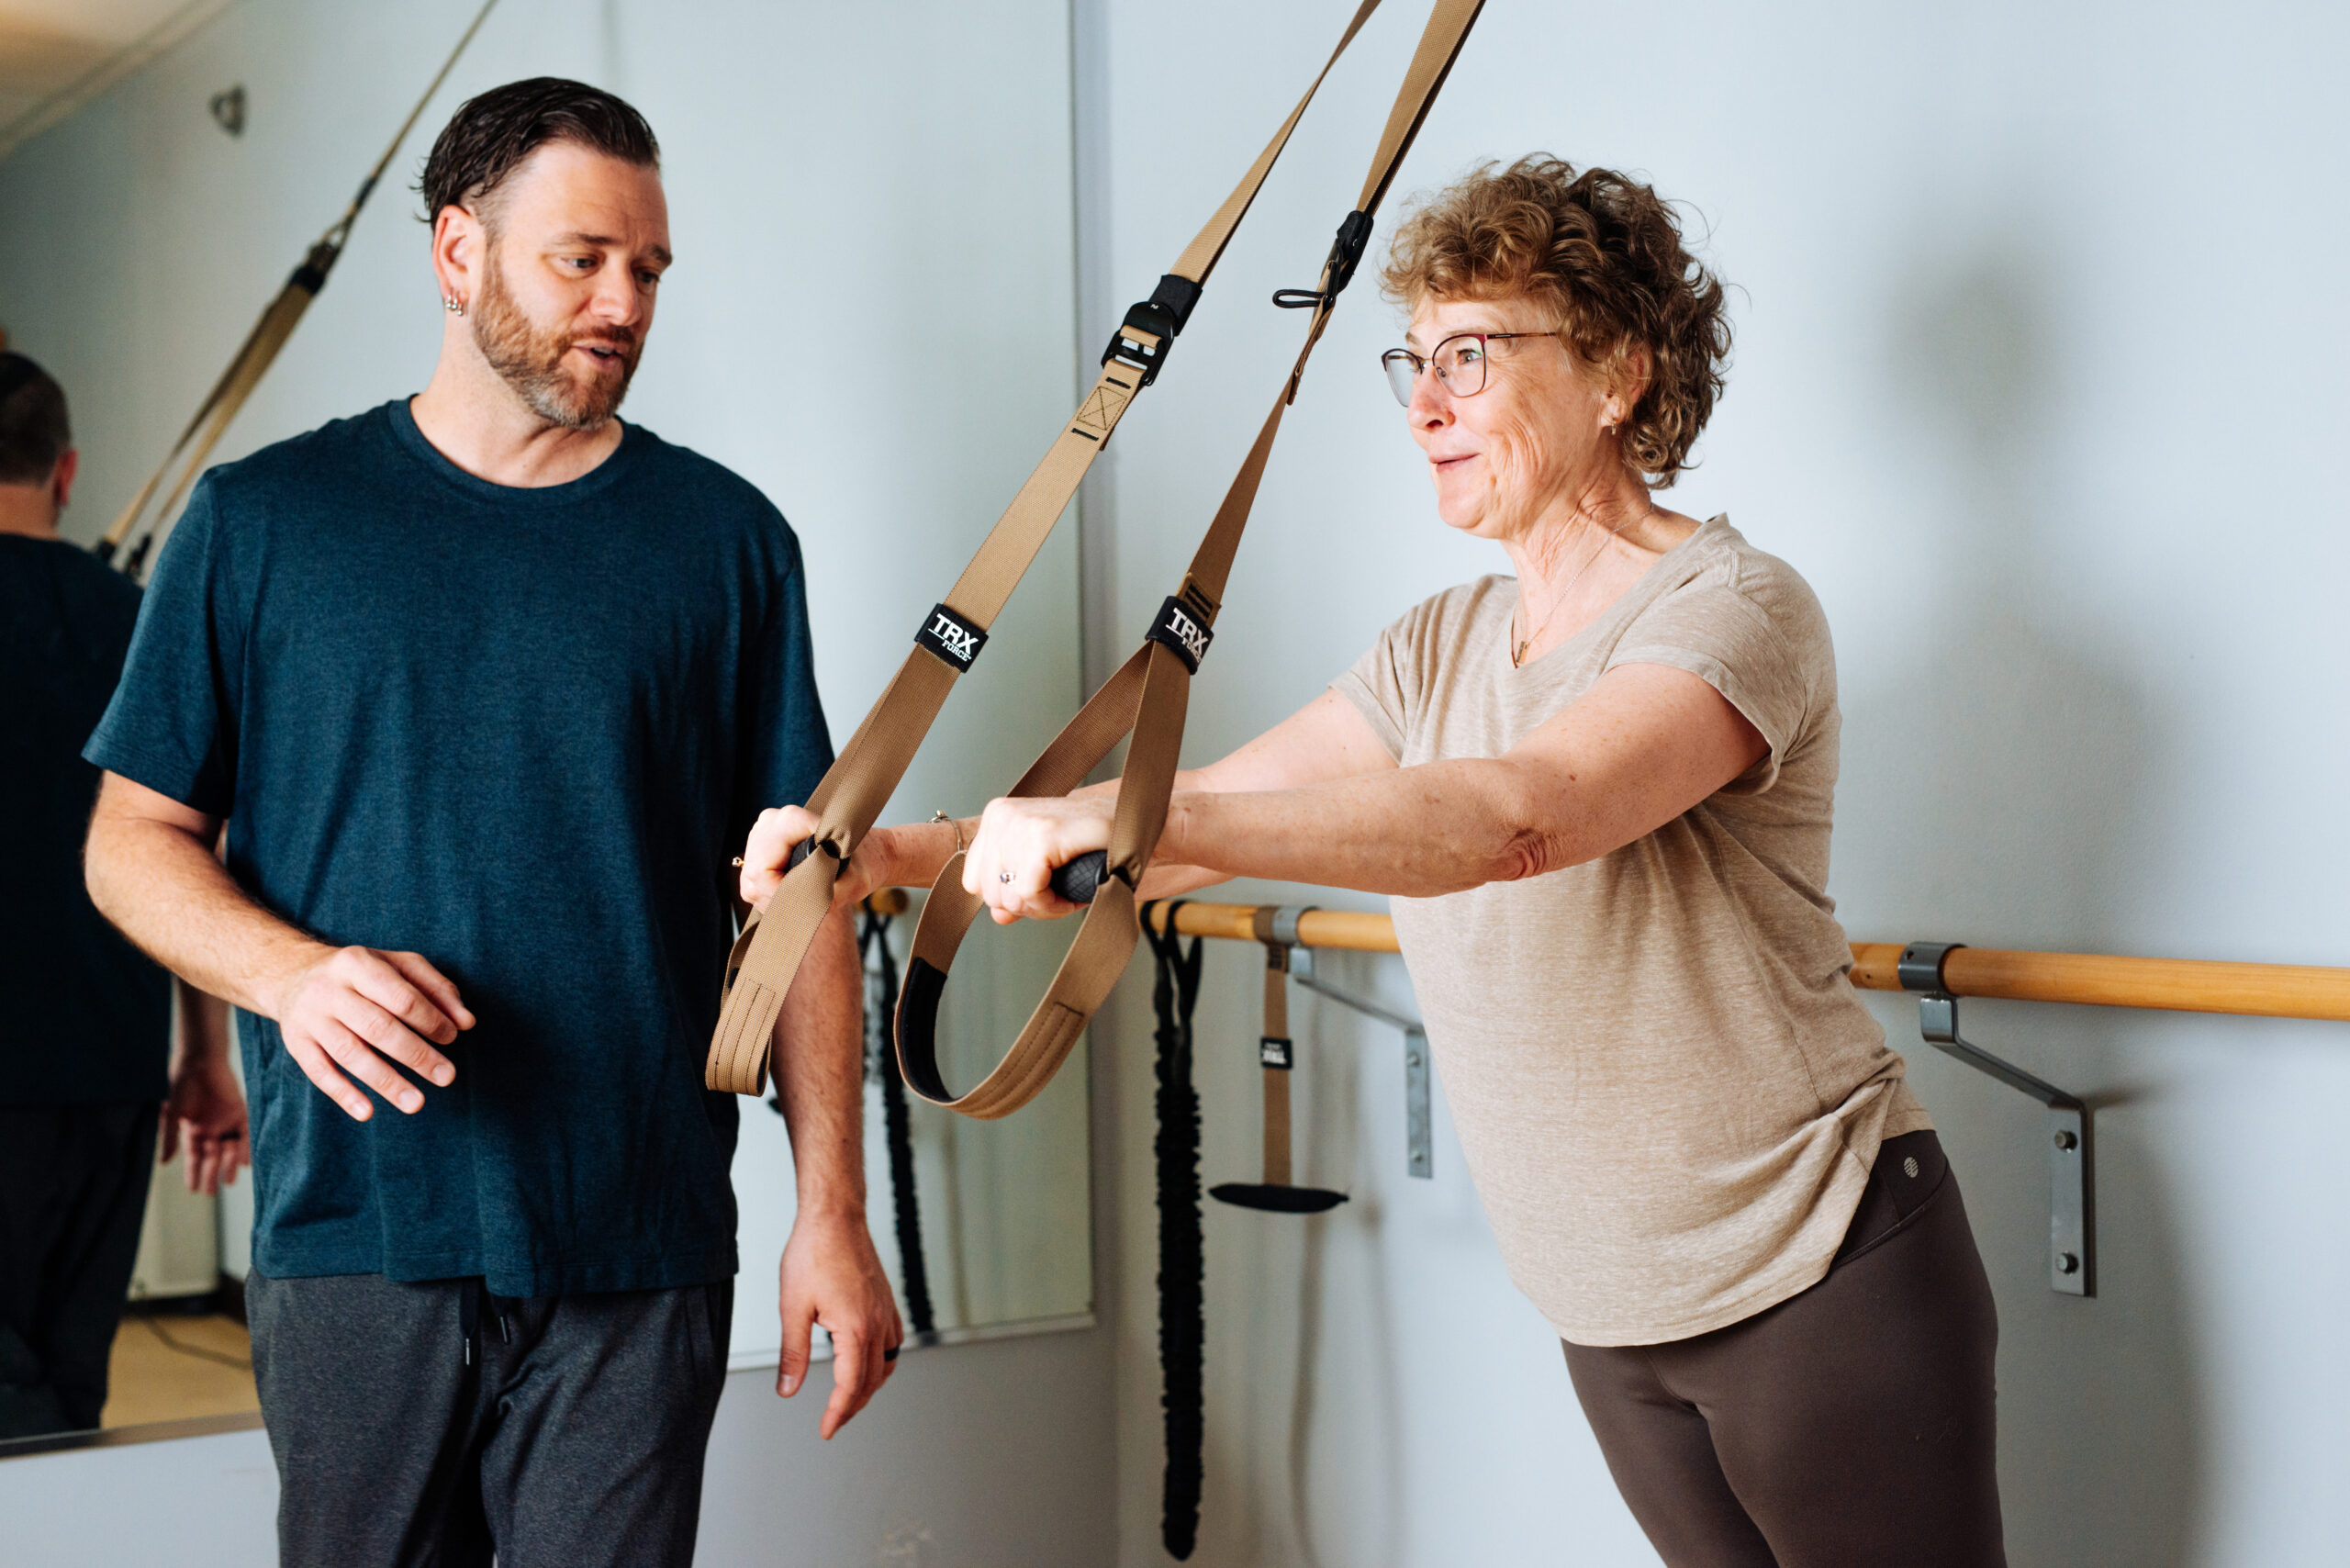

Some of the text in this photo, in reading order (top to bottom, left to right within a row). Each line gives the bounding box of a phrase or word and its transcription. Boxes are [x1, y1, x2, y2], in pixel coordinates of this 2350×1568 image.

[934, 613, 979, 655] TRX
[942, 639, 970, 662] FORCE
[1171, 607, 1209, 655] TRX
